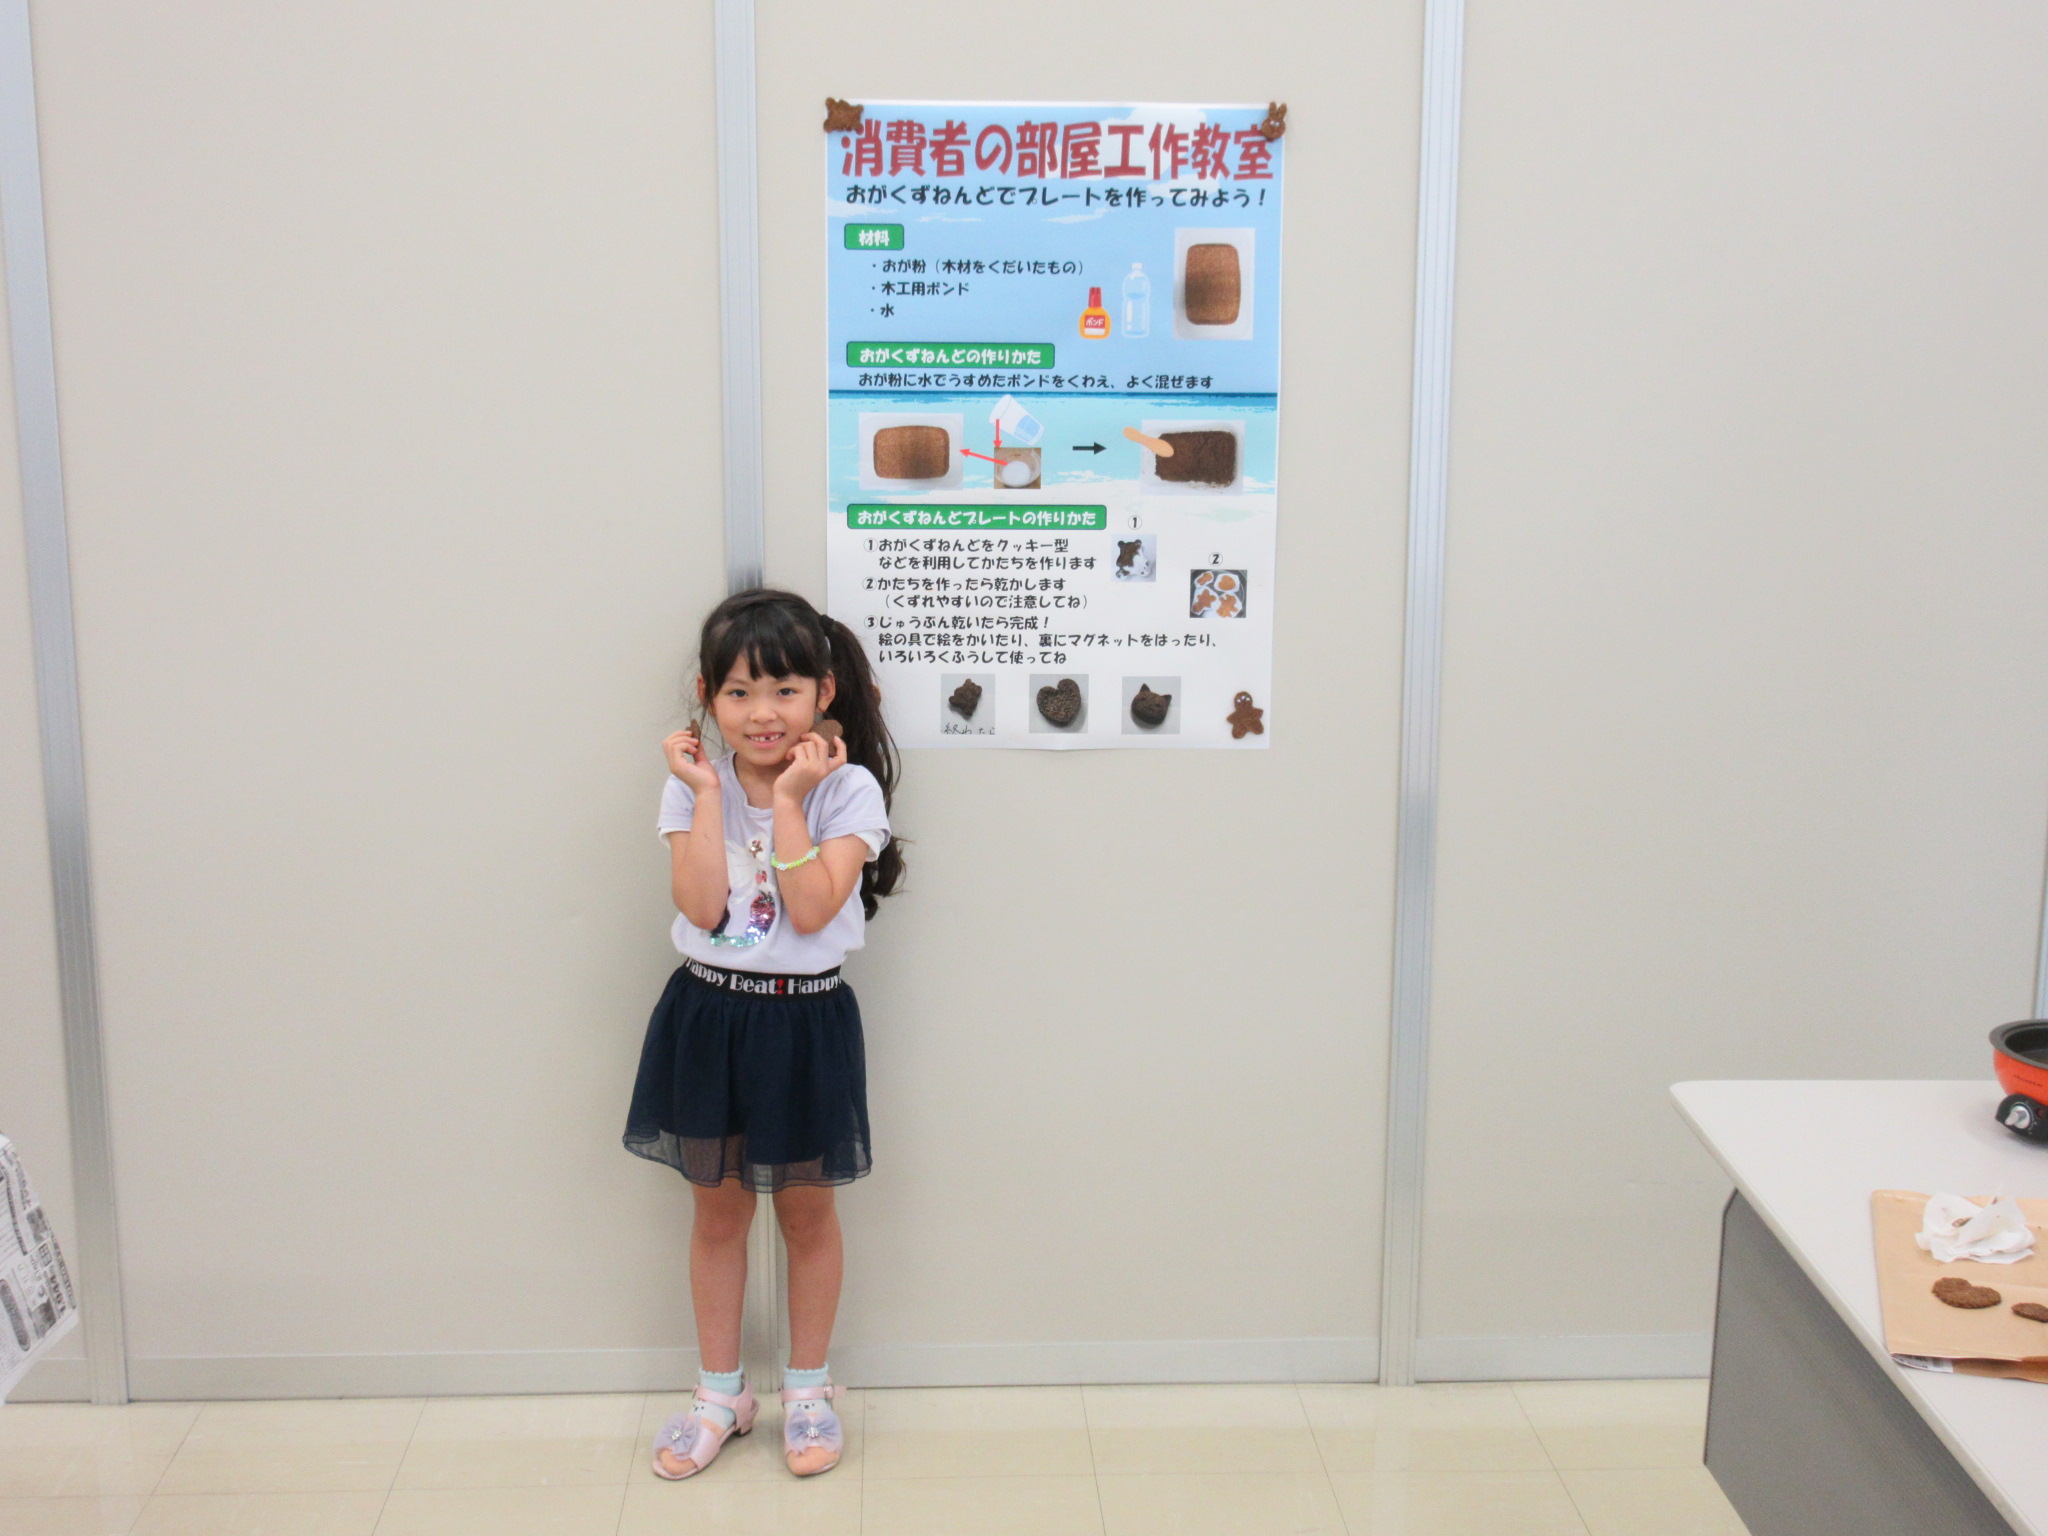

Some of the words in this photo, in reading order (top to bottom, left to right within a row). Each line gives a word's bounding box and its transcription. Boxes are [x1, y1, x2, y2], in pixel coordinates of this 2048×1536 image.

[841, 118, 1274, 181] 消費者の部屋工作教室
[846, 184, 1266, 208] おがくずねんどでプレートを作ってみよう！
[859, 229, 890, 246] 材料
[860, 348, 1042, 365] おがくずねんどの作りかた
[857, 511, 1096, 526] おがくずねんどプレートの作りかた
[879, 556, 1097, 571] などを利用してかたちを作ります
[879, 651, 1067, 665] いろいろくふうして使ってね
[729, 973, 784, 995] Beat!
